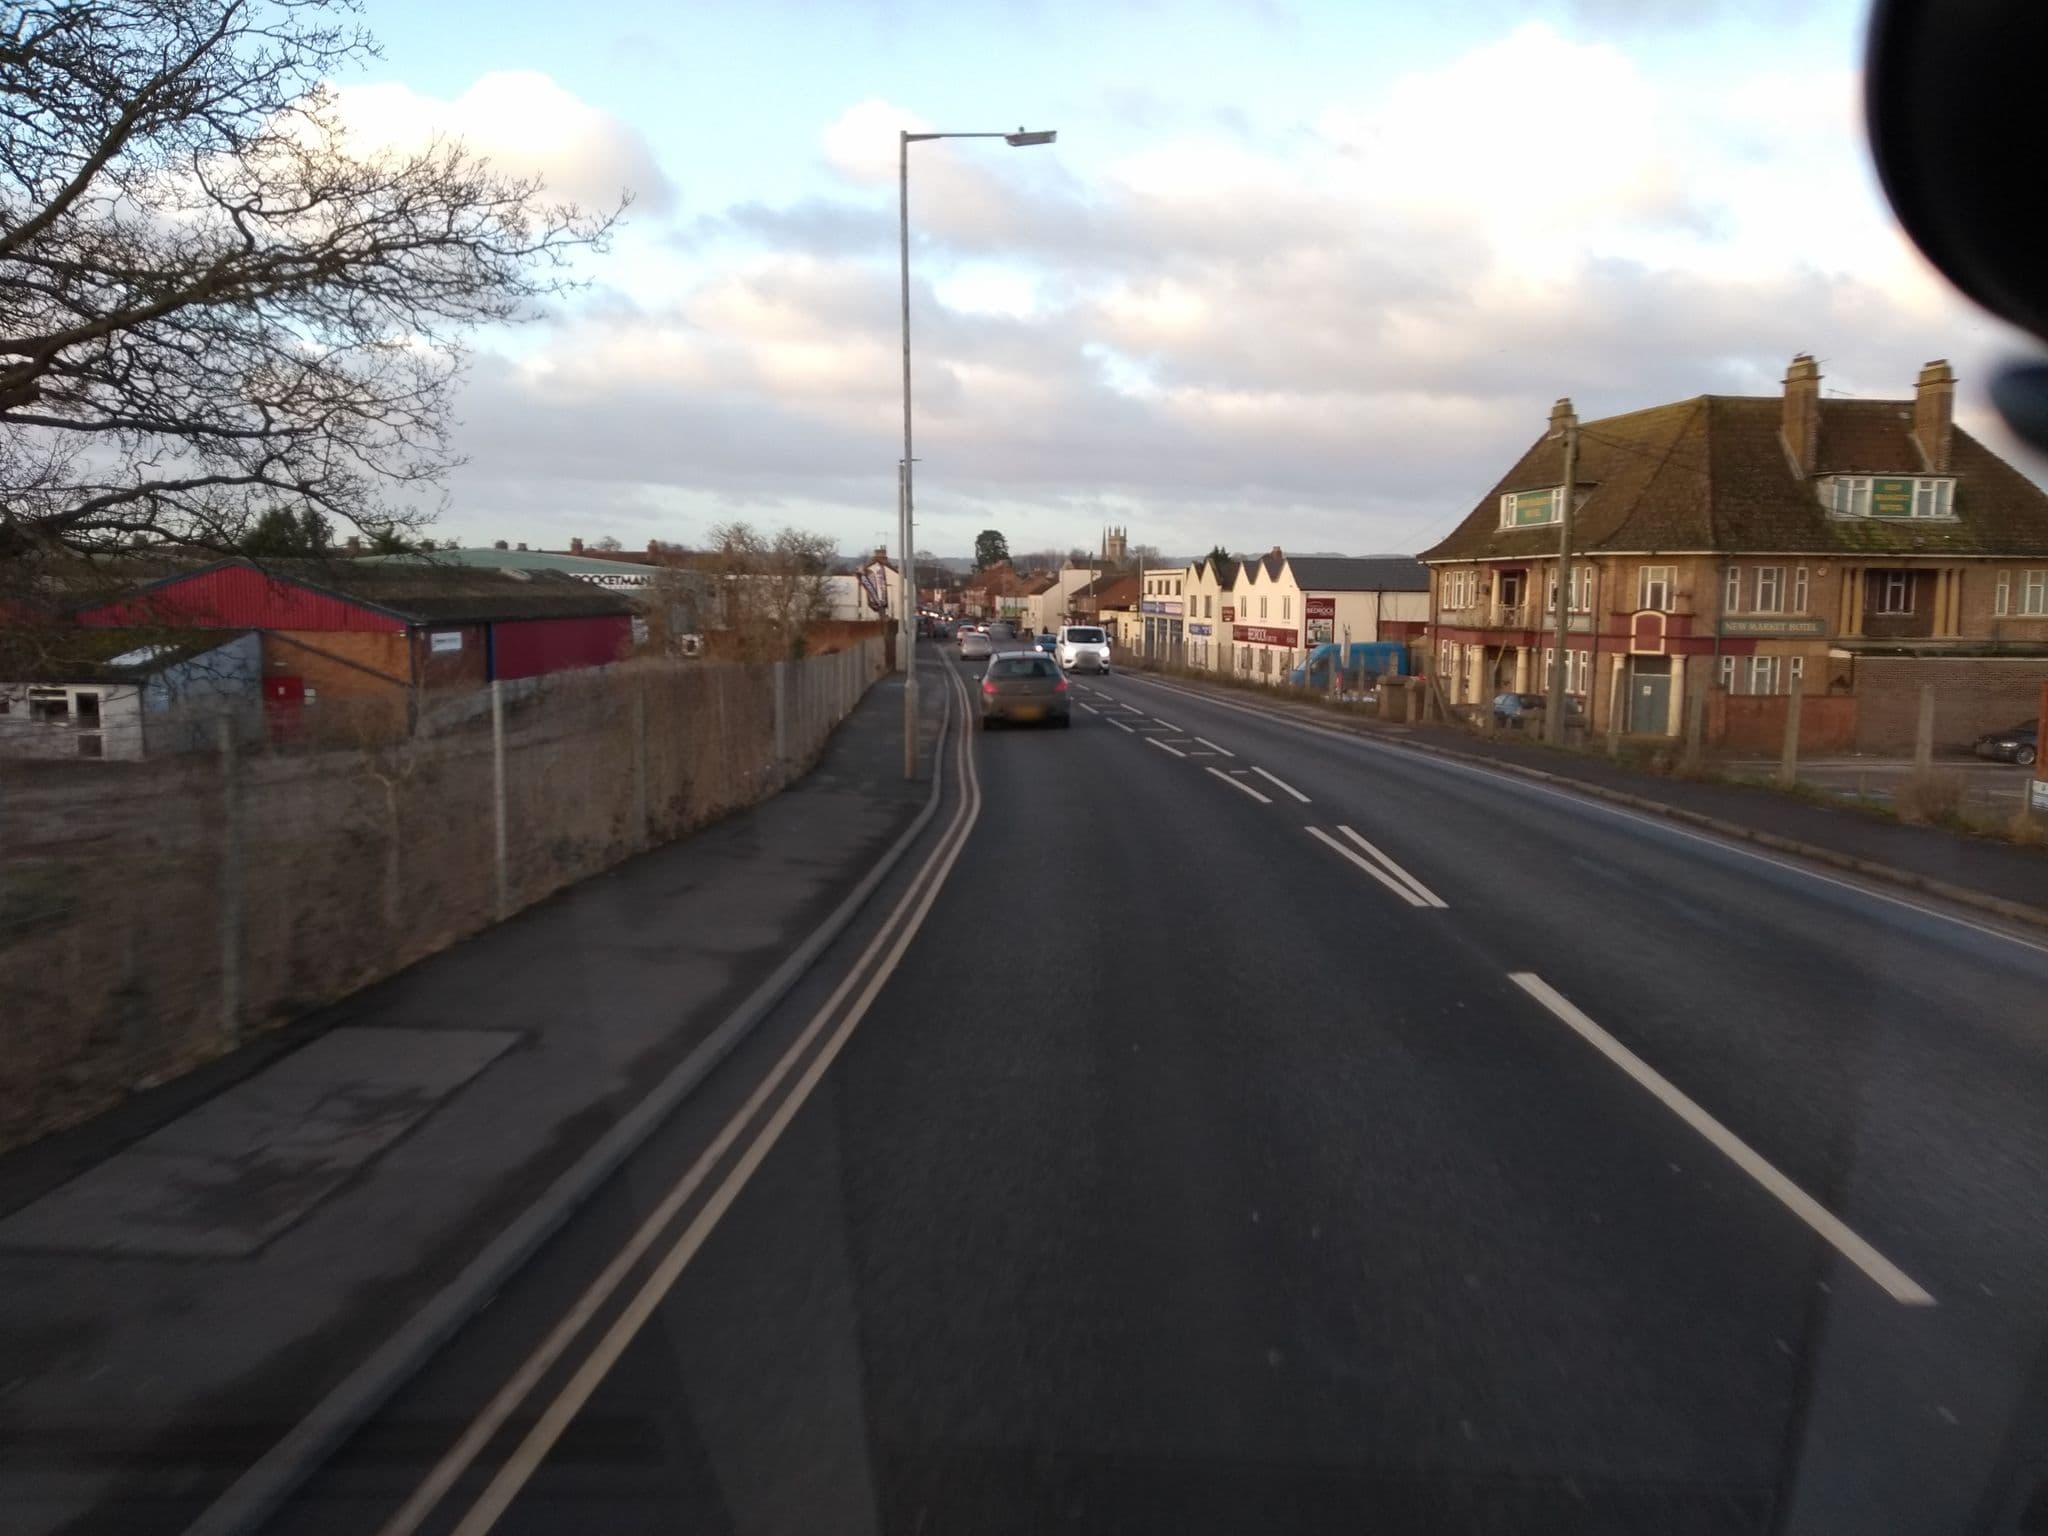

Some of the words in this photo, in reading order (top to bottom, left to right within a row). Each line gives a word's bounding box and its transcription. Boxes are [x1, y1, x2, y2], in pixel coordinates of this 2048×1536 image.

[1725, 622, 1746, 632] NEW
[1749, 622, 1785, 632] MARKET
[1789, 622, 1817, 632] HOTEL
